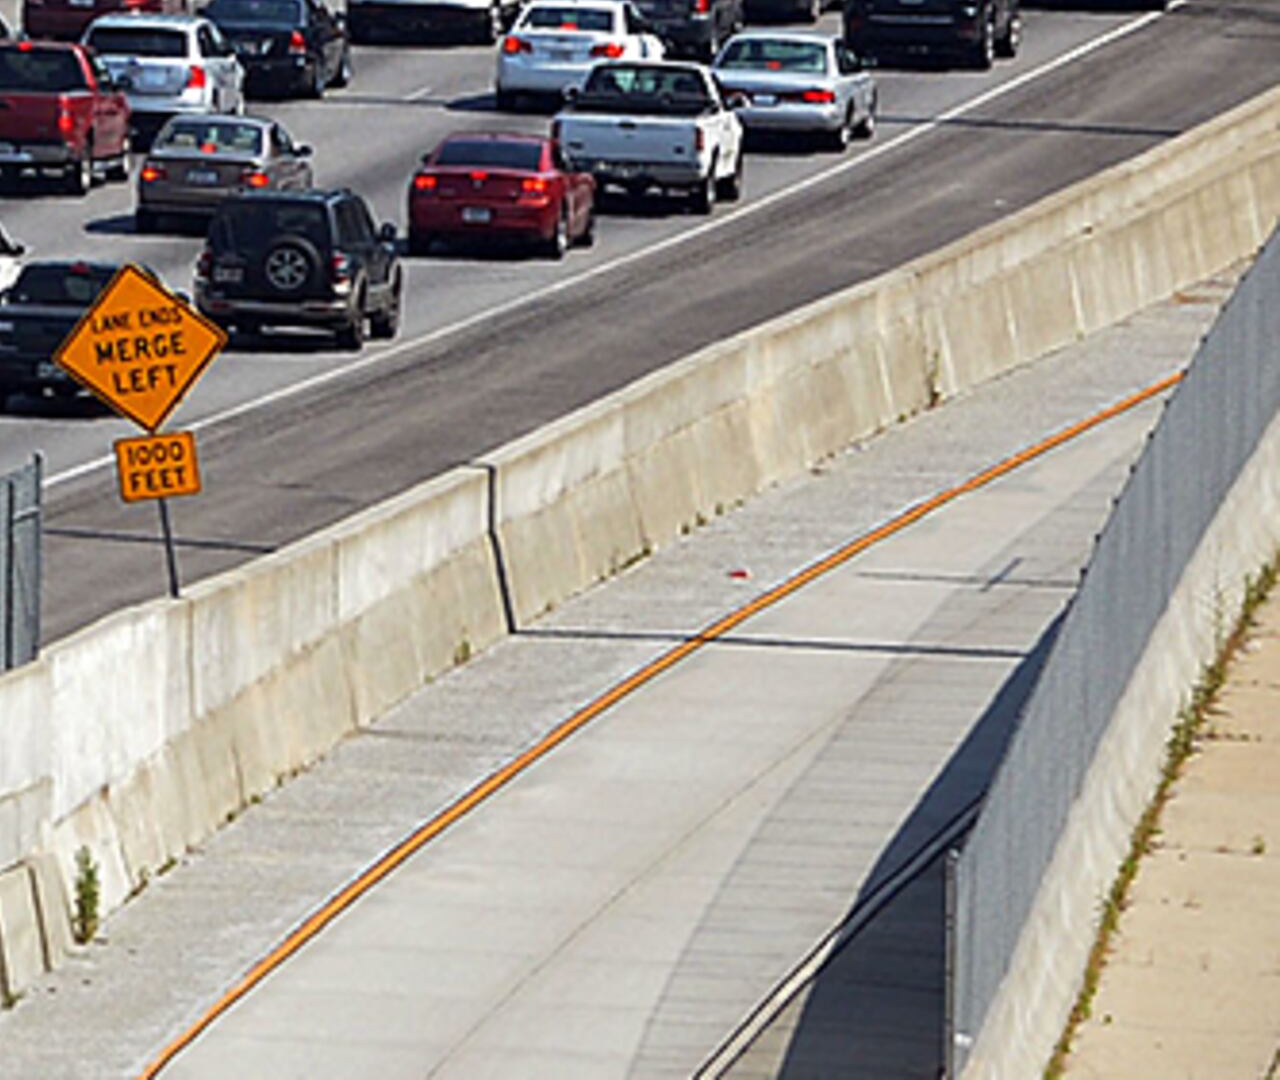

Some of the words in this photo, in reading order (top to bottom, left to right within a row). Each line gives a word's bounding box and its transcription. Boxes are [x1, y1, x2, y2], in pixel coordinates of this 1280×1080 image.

[93, 314, 134, 334] LANE
[139, 307, 183, 328] ENDS
[95, 333, 186, 365] MERGE
[112, 365, 176, 395] LEFT
[127, 442, 184, 464] 1000
[130, 467, 185, 493] FEET
